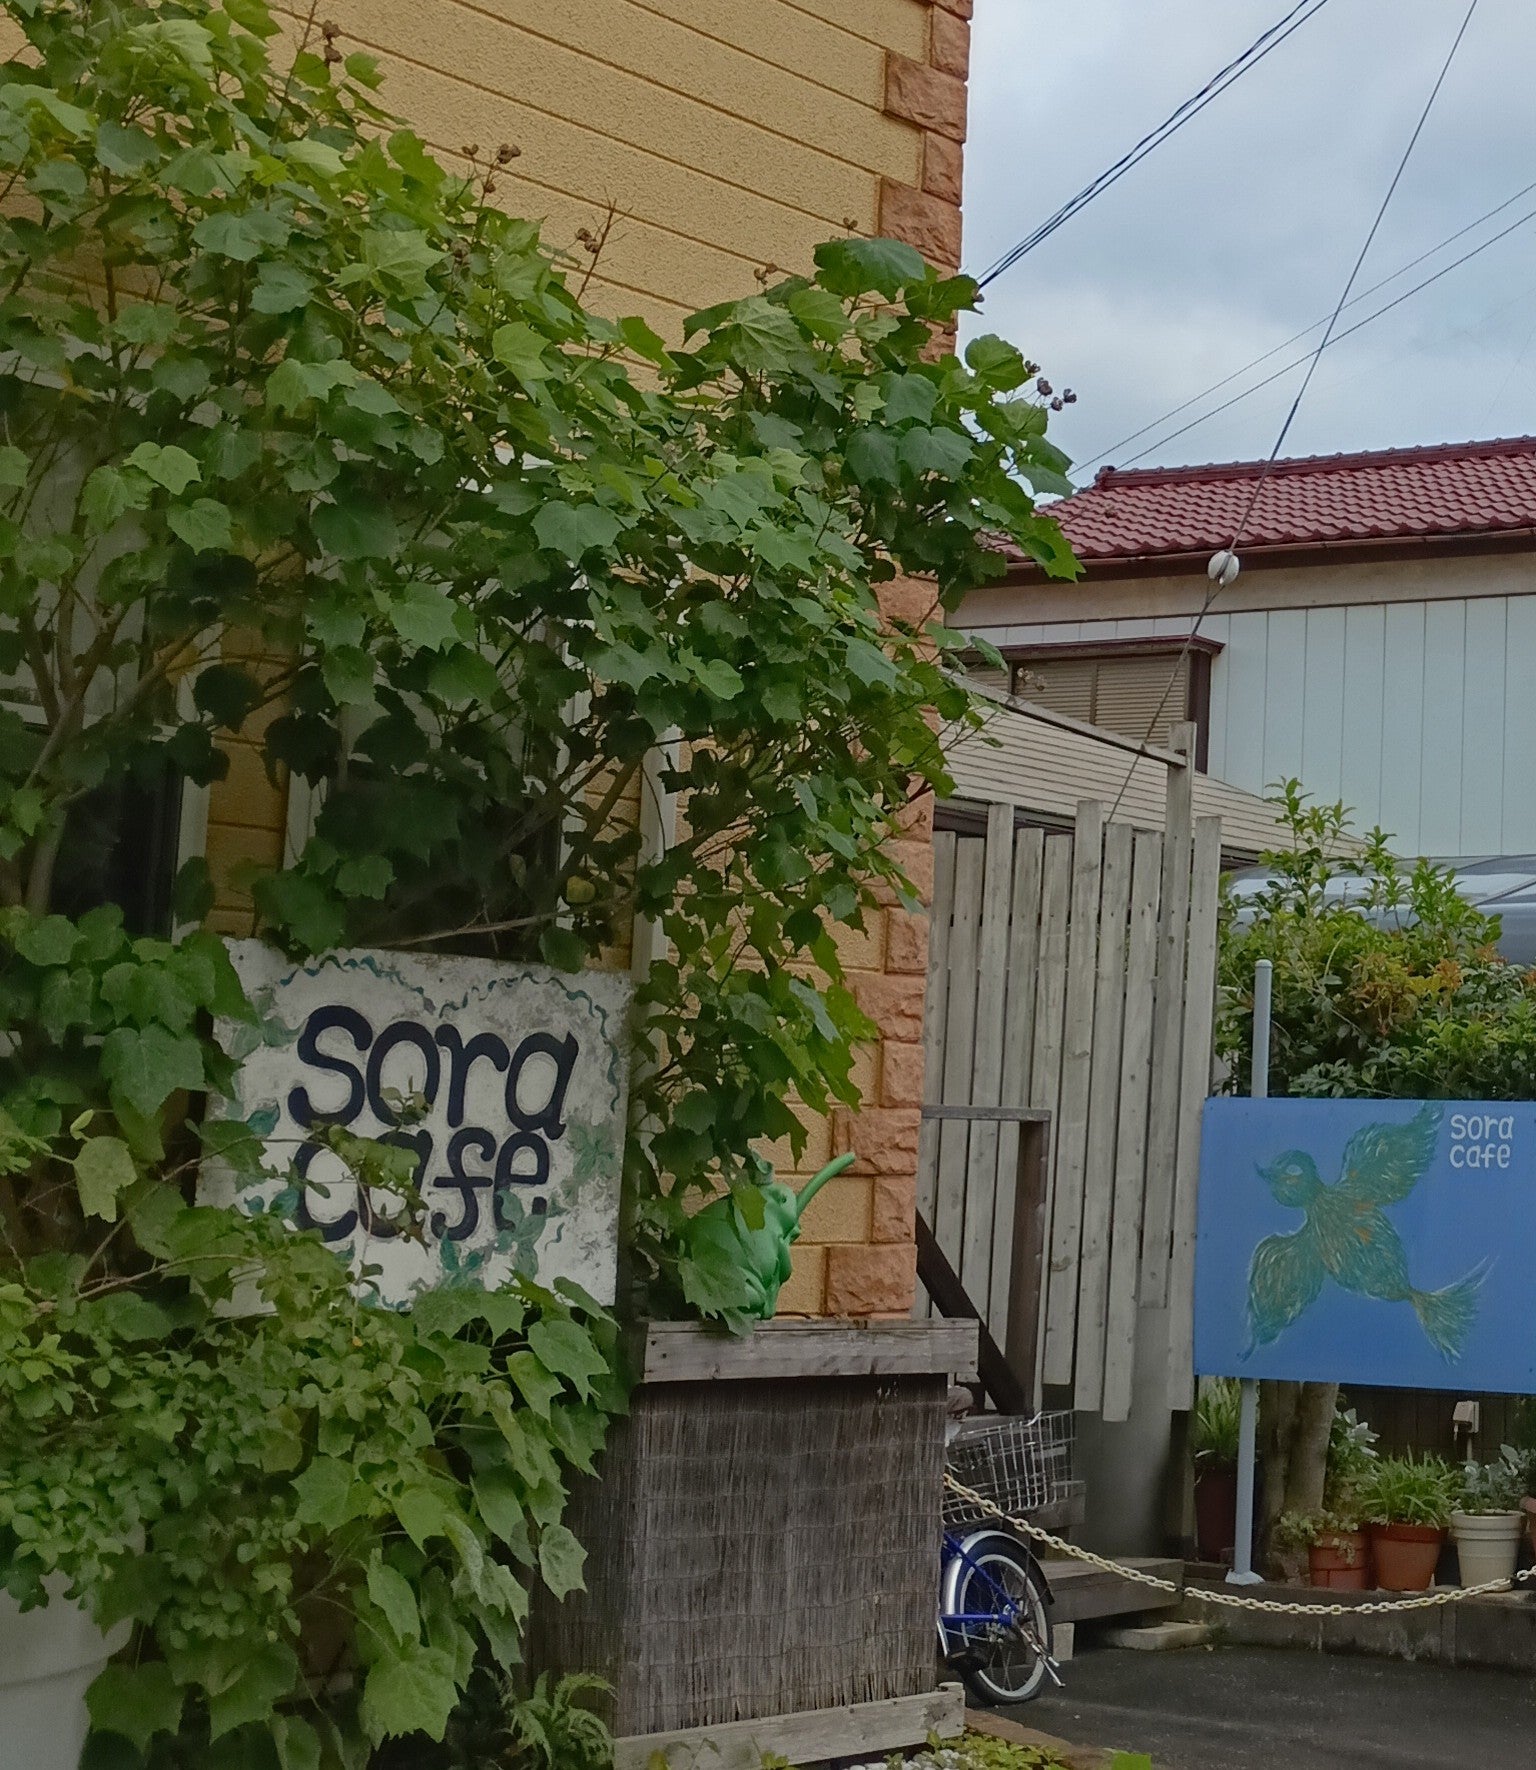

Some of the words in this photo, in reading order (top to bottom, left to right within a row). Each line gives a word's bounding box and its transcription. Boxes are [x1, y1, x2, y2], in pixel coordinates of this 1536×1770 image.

[288, 1005, 579, 1140] sora
[1449, 1143, 1511, 1169] cafe
[1450, 1113, 1515, 1141] sora
[293, 1126, 550, 1243] cafe
